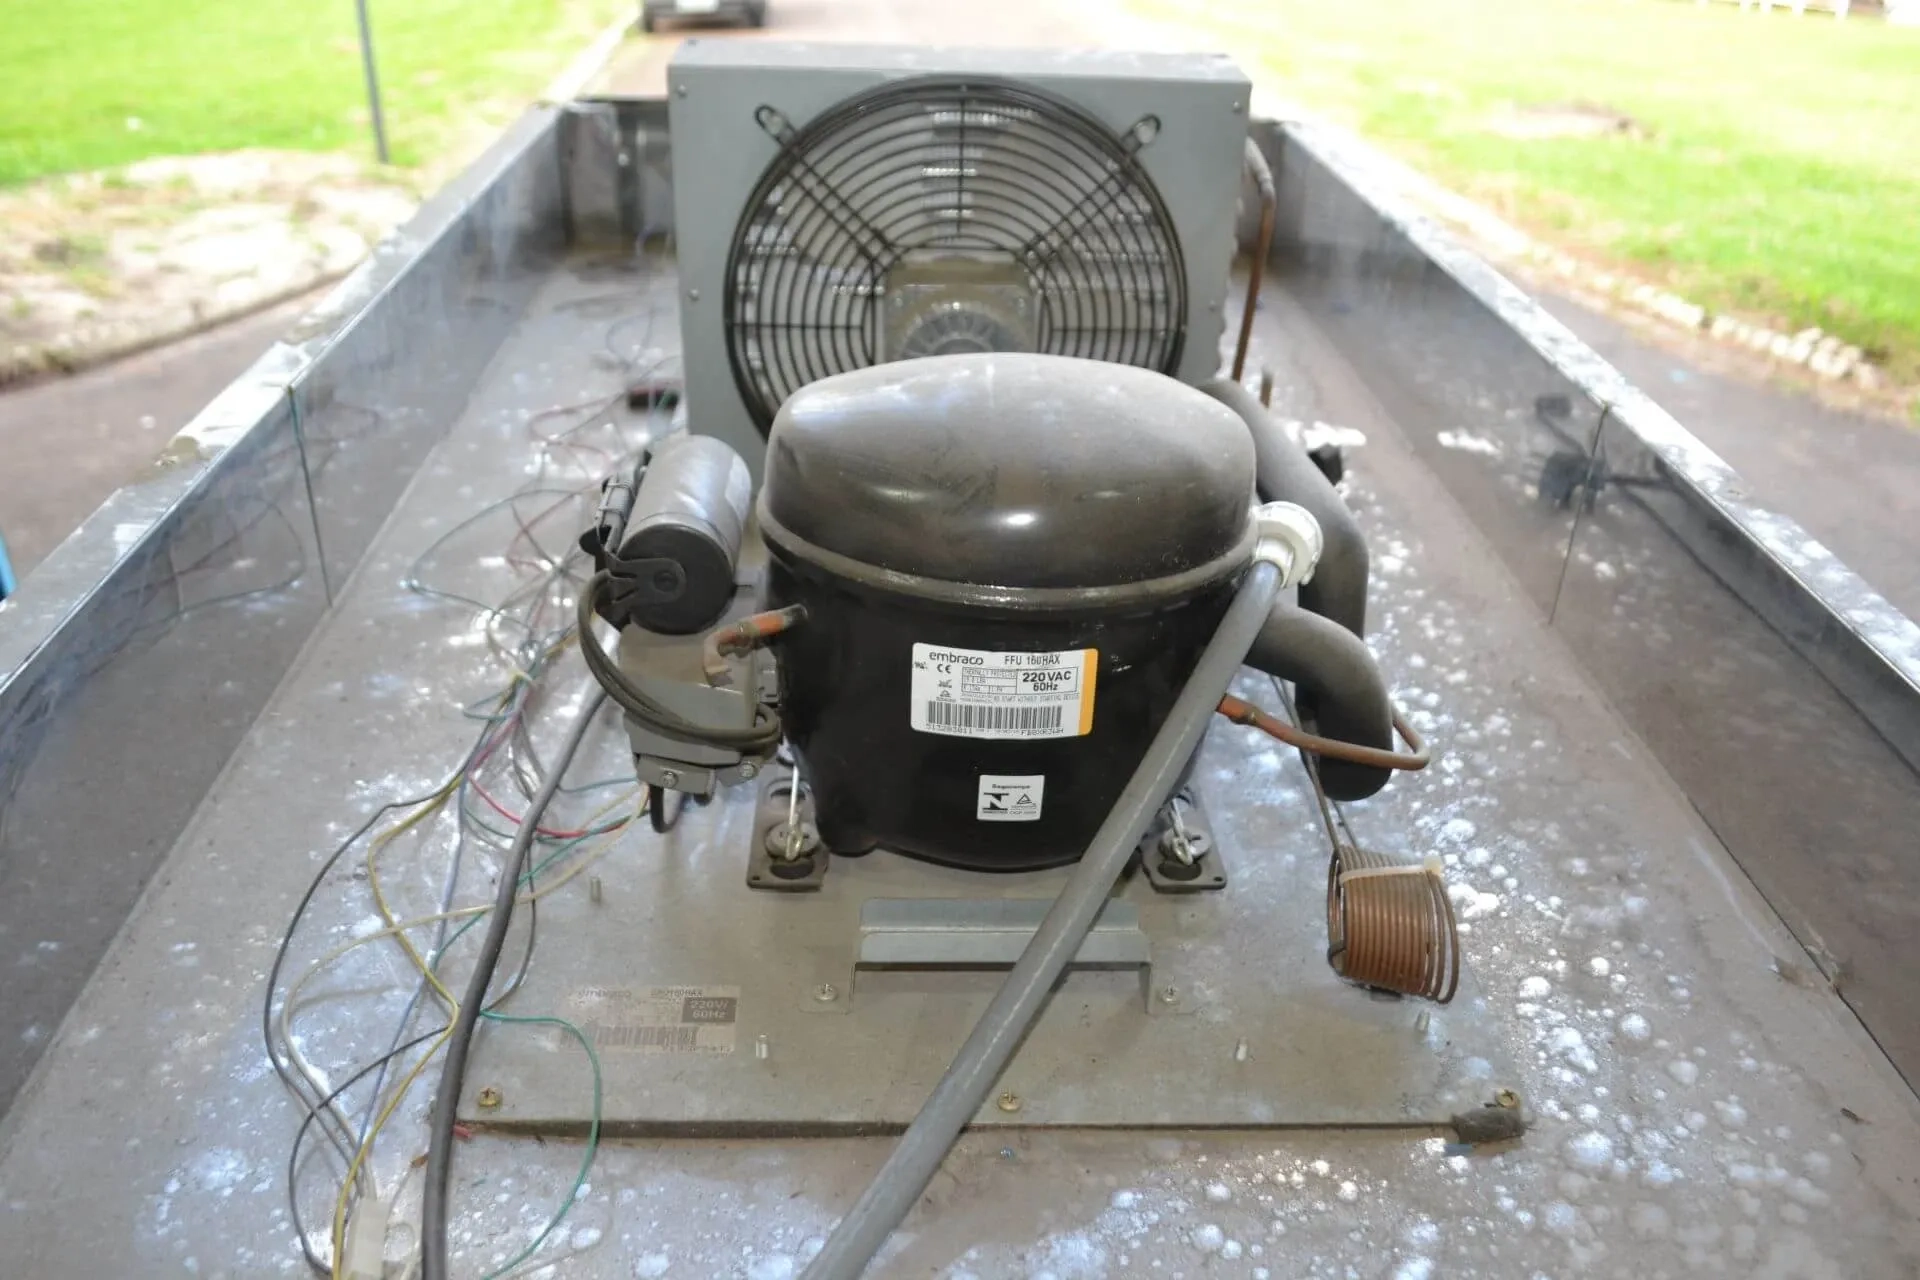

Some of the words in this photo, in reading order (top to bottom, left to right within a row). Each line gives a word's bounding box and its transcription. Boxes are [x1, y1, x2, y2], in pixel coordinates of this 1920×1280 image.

[929, 652, 984, 665] embraco
[1004, 655, 1022, 666] FFU
[1033, 682, 1059, 692] 60Hz
